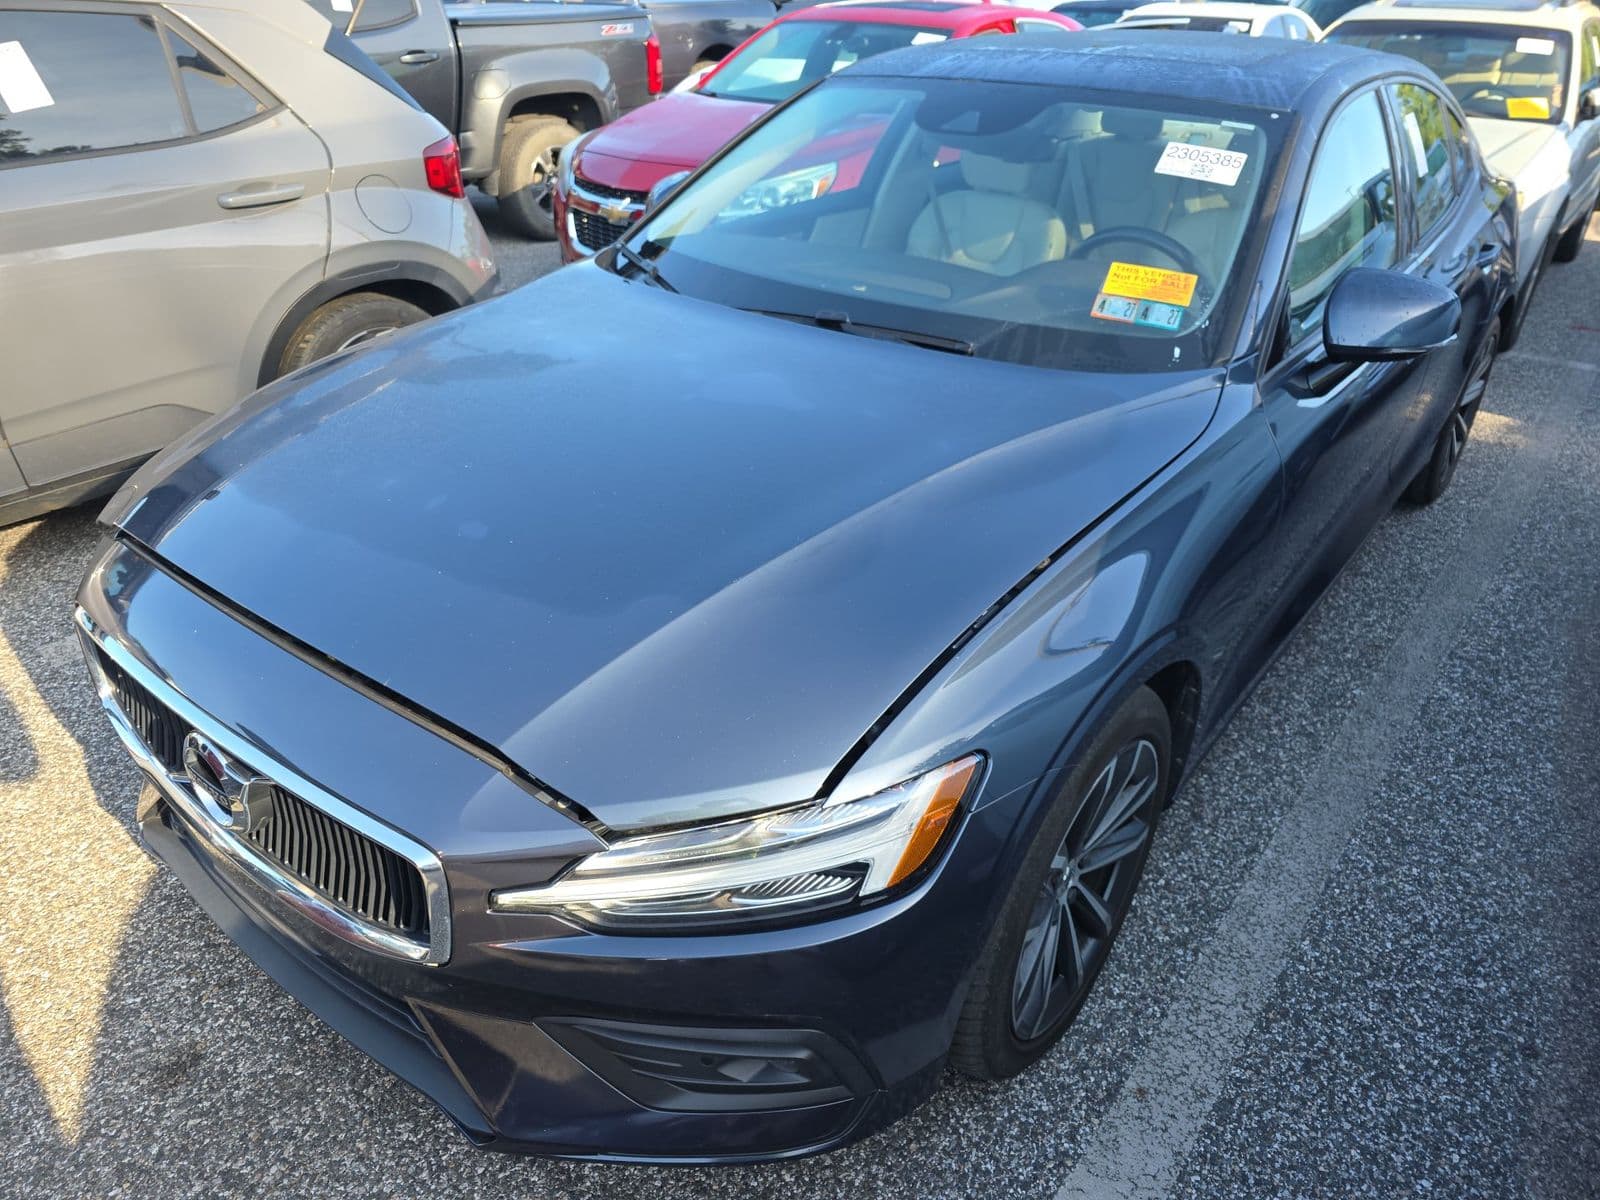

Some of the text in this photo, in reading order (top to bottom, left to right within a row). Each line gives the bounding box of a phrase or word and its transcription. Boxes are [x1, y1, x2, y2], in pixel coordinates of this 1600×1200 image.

[1167, 146, 1243, 168] 2305385
[1115, 265, 1192, 282] THIS VEHICLE
[1134, 276, 1157, 284] FOR
[1141, 306, 1180, 325] 4 27
